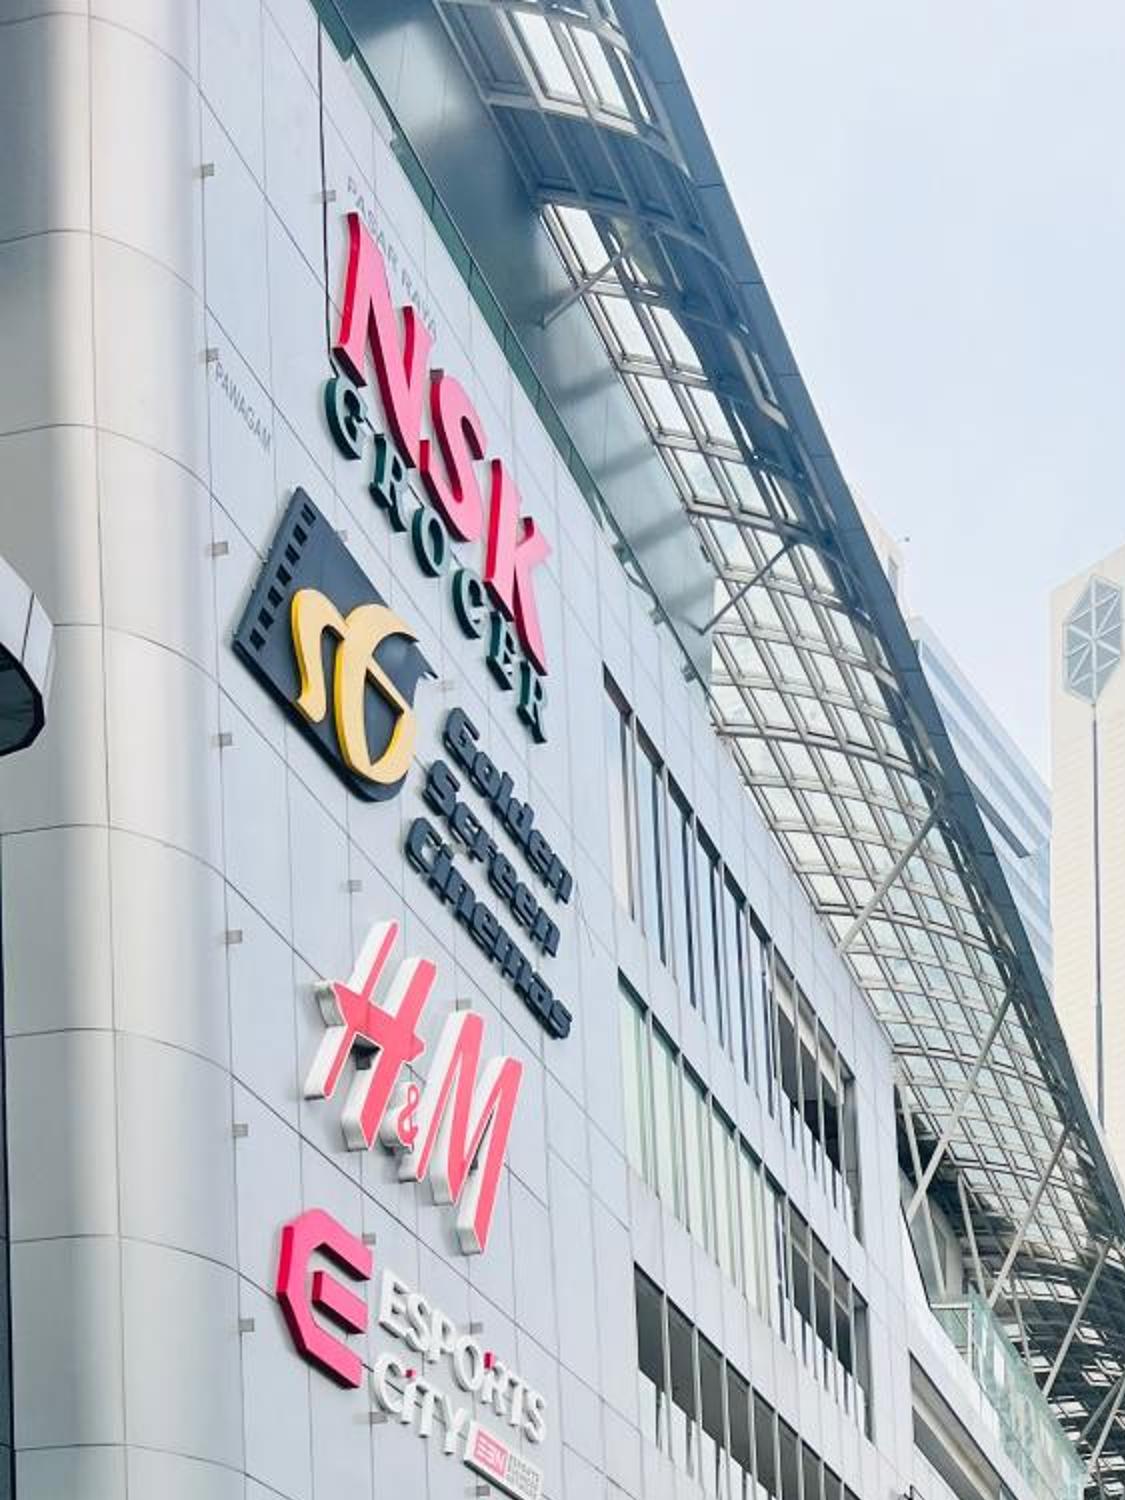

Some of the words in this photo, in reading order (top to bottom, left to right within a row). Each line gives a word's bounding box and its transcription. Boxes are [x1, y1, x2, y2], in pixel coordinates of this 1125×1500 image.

[215, 361, 272, 455] PAWAGAM
[334, 210, 553, 676] NSK
[323, 377, 547, 743] GROCER
[422, 759, 561, 957] Screen
[442, 707, 573, 904] Golden
[404, 817, 573, 1039] Cinemas
[303, 918, 525, 1256] H&M
[378, 1267, 547, 1444] ESPORTS
